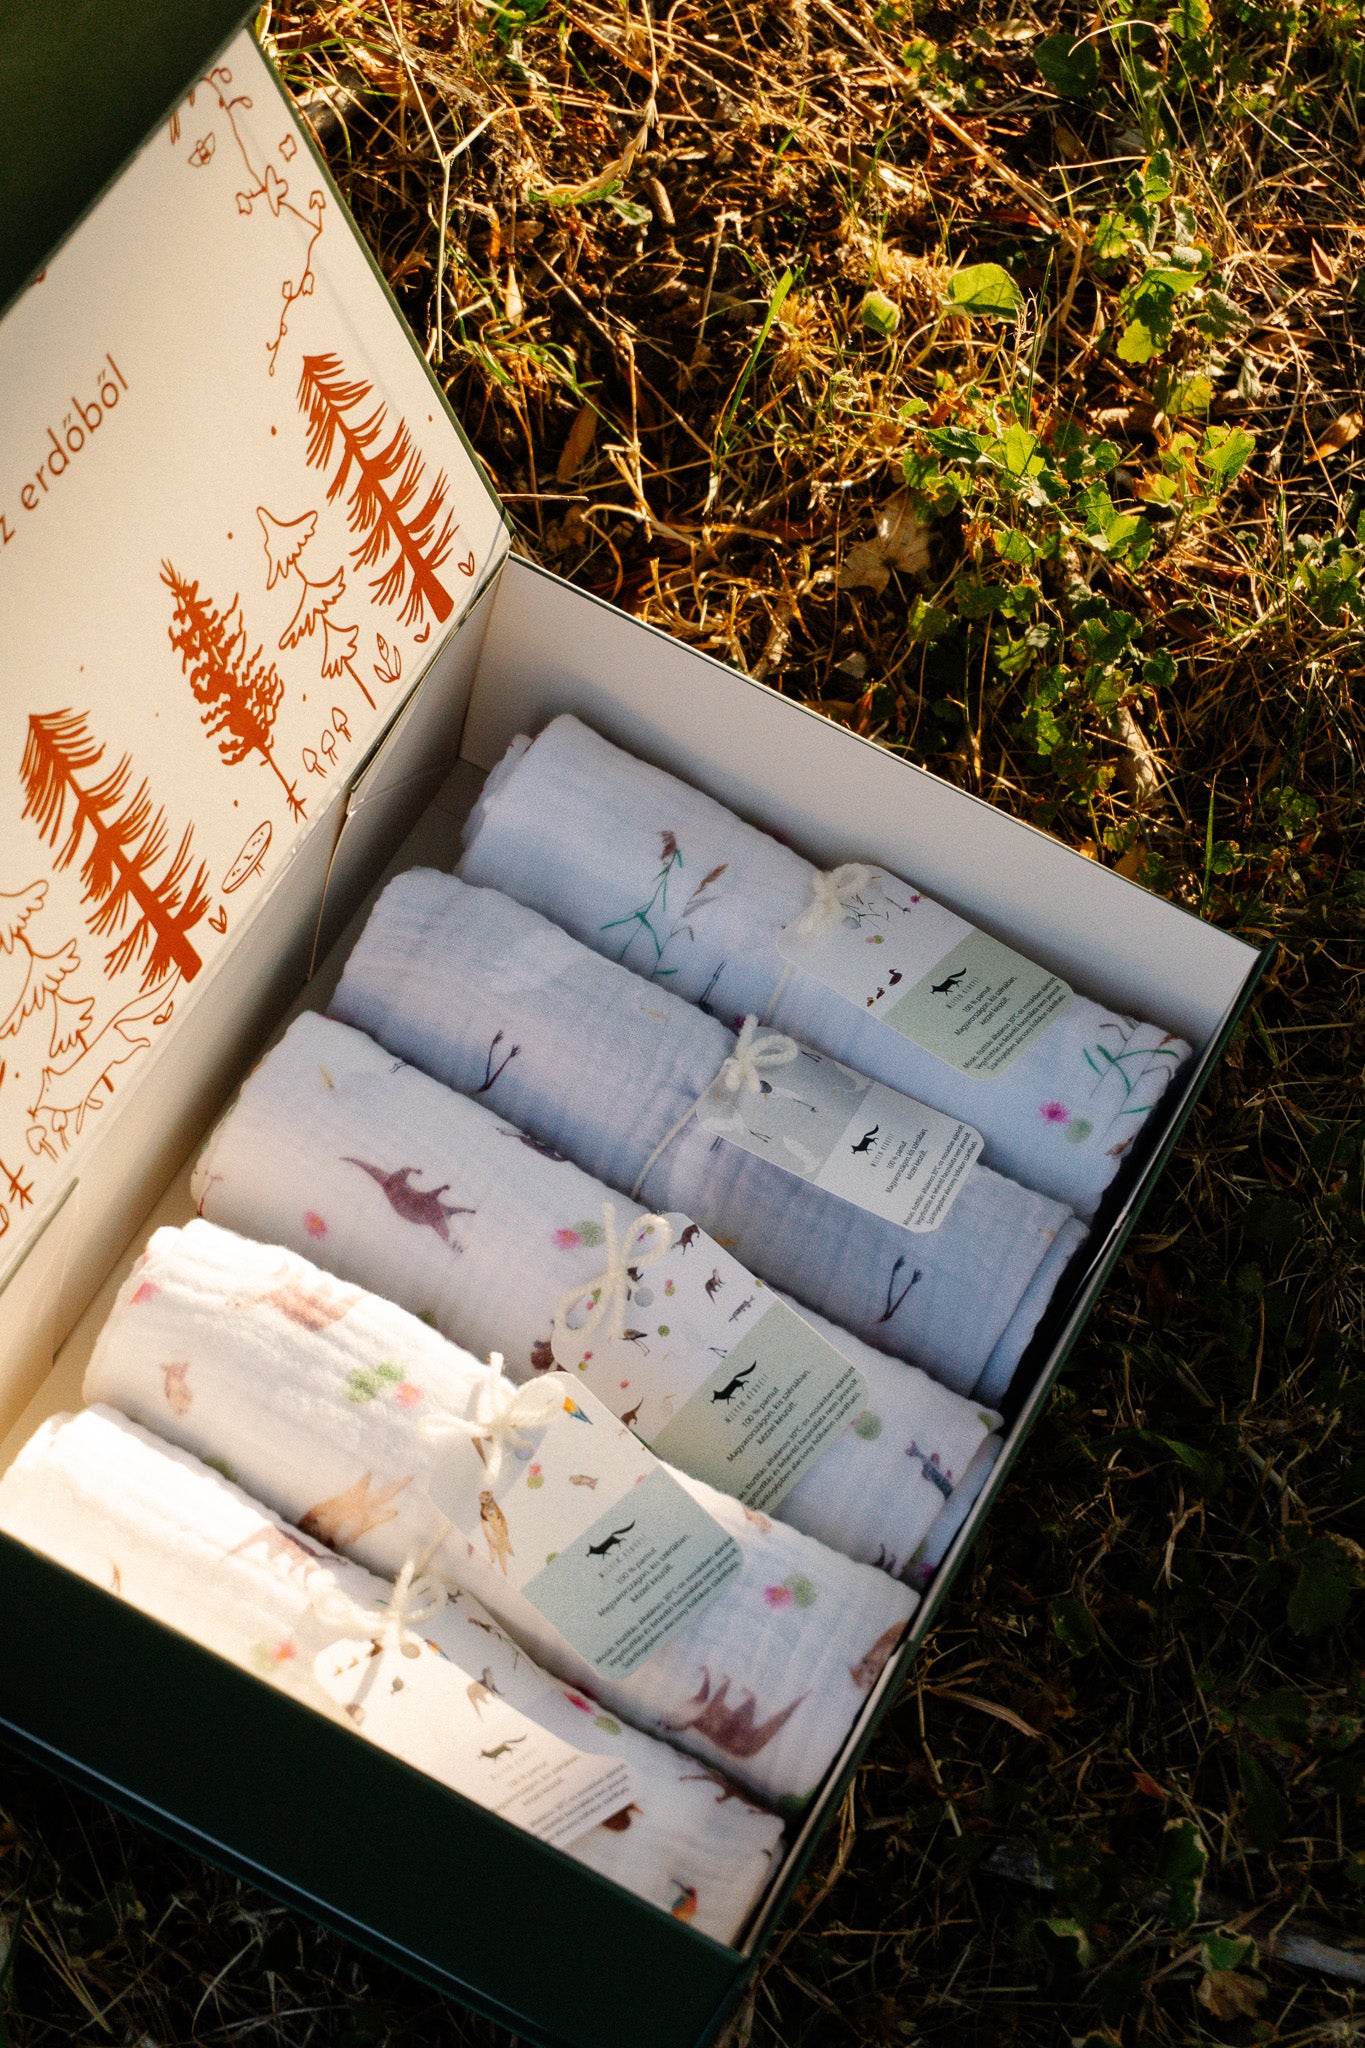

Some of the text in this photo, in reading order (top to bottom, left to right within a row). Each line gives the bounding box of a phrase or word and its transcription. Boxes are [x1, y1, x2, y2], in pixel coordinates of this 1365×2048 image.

[21, 353, 129, 511] erdőből
[741, 1413, 755, 1428] 100
[759, 1385, 780, 1410] pamut
[771, 1398, 783, 1410] kis
[755, 1422, 777, 1445] kézzel
